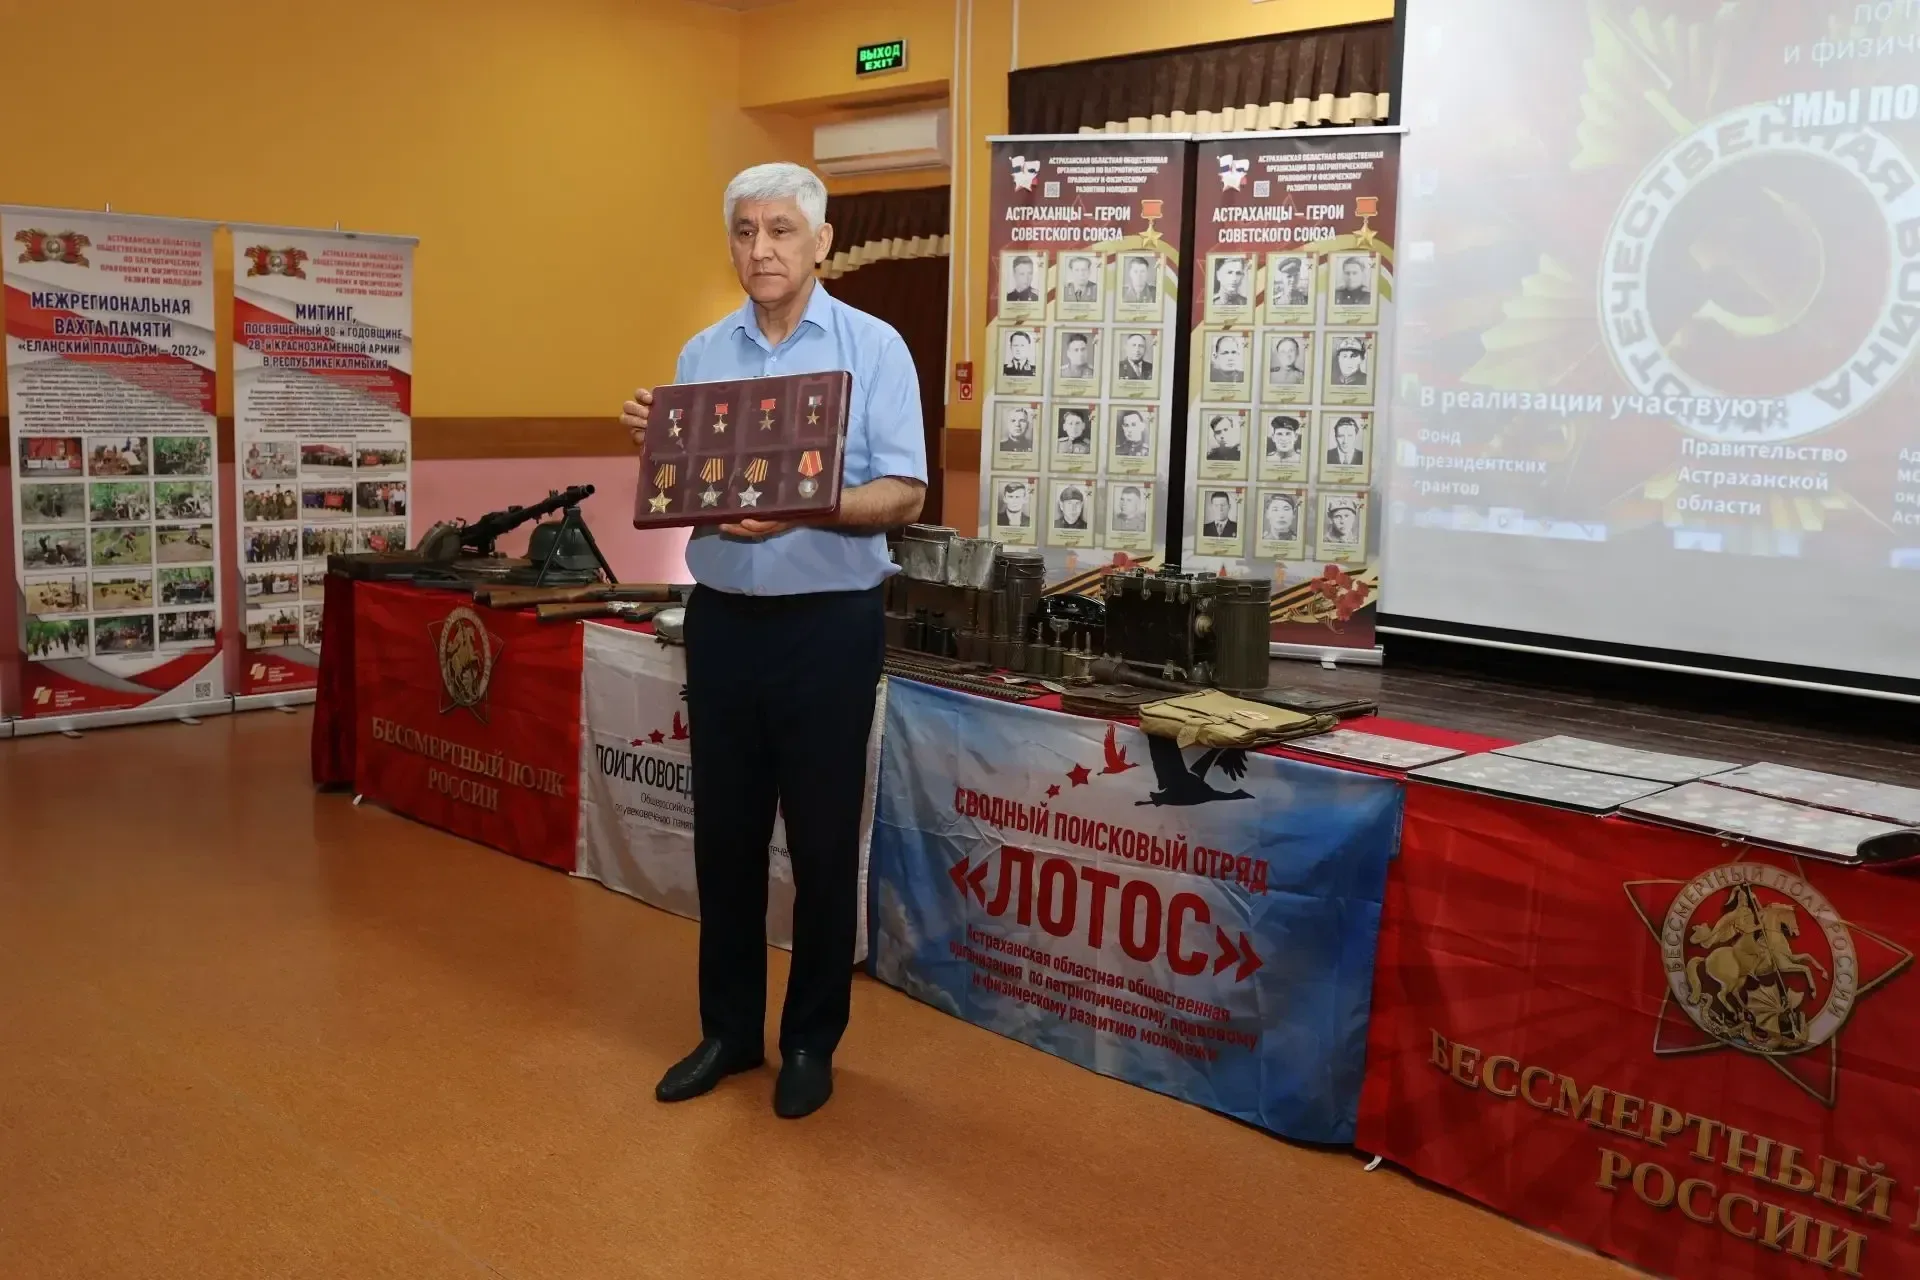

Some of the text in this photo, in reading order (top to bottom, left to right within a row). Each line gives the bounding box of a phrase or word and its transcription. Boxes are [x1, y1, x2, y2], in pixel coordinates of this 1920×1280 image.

[859, 44, 900, 62] ВЫХОД
[1783, 33, 1920, 69] и физич
[865, 57, 894, 71] EXIT
[1005, 206, 1081, 223] АСТРАХАНЦЫ
[1095, 206, 1131, 221] ГЕРОИ
[1213, 206, 1292, 223] АСТРАХАНЦЫ
[1306, 205, 1345, 221] ГЕРОИ
[1011, 227, 1123, 242] СОВЕТСКОГО СОЮЗА
[1218, 226, 1336, 243] СОВЕТСКОГО СОЮЗА
[31, 291, 191, 315] МЕЖРЕГИОНАЛЬНАЯ
[295, 303, 357, 324] МИТИНГ,
[55, 319, 172, 338] ВАХТА ПАМЯТИ
[245, 323, 321, 336] ПОСВЯЩЕННЫЙ
[347, 327, 402, 340] ГОДОВЩИНЕ
[18, 338, 92, 353] «ЕЛАНСКИЙ
[94, 341, 157, 358] ПЛАЦДАРМ
[172, 344, 206, 357] 2022»
[274, 340, 366, 353] КРАСНОЗНАМЕННОЙ
[369, 343, 400, 355] АРМИИ
[263, 356, 388, 369] В РЕСПУБЛИКЕ КАЛМЫКИЯ
[1420, 386, 1786, 423] В реализации участвуют:
[1418, 428, 1462, 447] Фонд
[1681, 438, 1848, 463] Правительство
[1416, 454, 1547, 473] президентских
[1677, 465, 1829, 491] Астраханской
[1676, 494, 1761, 516] области
[371, 716, 565, 797] БЕССМЕРТНЫЙ ПОЛК
[428, 768, 499, 811] РОССИИ
[954, 786, 1268, 896] СВОДНЫЙ ПОИСКОВЫЙ ОТРЯД
[948, 844, 1264, 983] «ЛОТОС»
[967, 923, 1231, 1022] Астраханская областная общественная
[950, 939, 1022, 981] организация
[1028, 969, 1043, 987] по
[1046, 976, 1169, 1029] патриотическому,
[972, 971, 980, 987] и
[983, 973, 1067, 1017] физическому
[1069, 1006, 1136, 1040] развитию
[1428, 1027, 1896, 1223] БЕССМЕРТНЫЙ
[1596, 1146, 1869, 1279] РОССИИ
